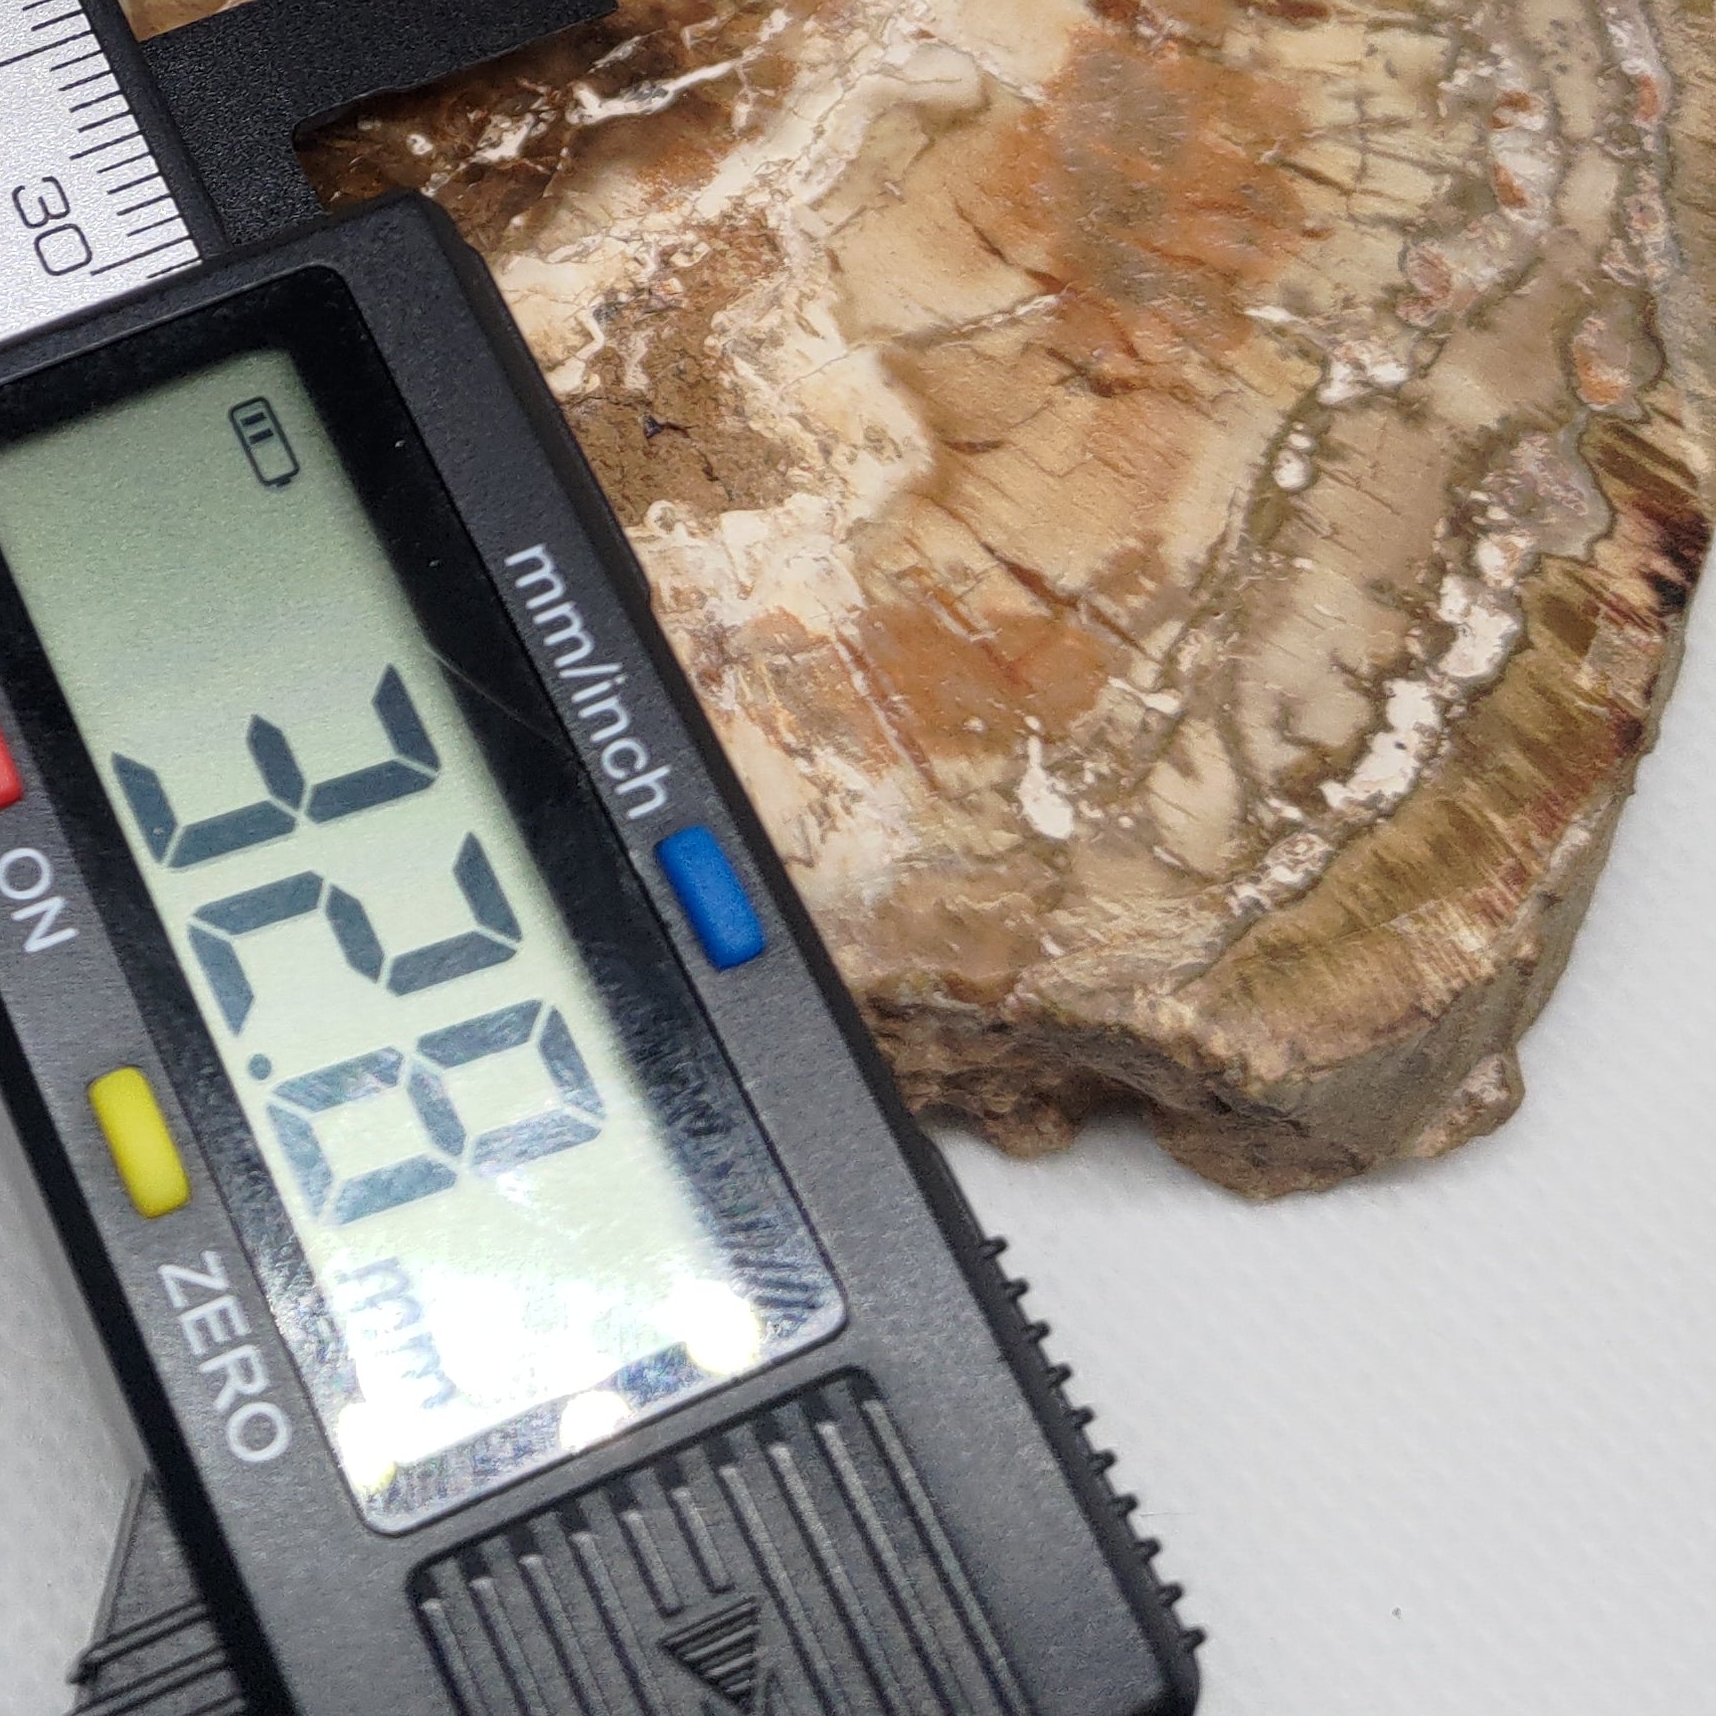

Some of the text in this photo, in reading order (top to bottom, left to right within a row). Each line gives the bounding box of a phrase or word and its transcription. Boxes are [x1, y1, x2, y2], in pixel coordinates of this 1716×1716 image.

[12, 176, 93, 277] 30
[503, 542, 673, 820] mm/inch
[111, 662, 609, 1227] 32.8
[156, 1250, 289, 1464] ZERO
